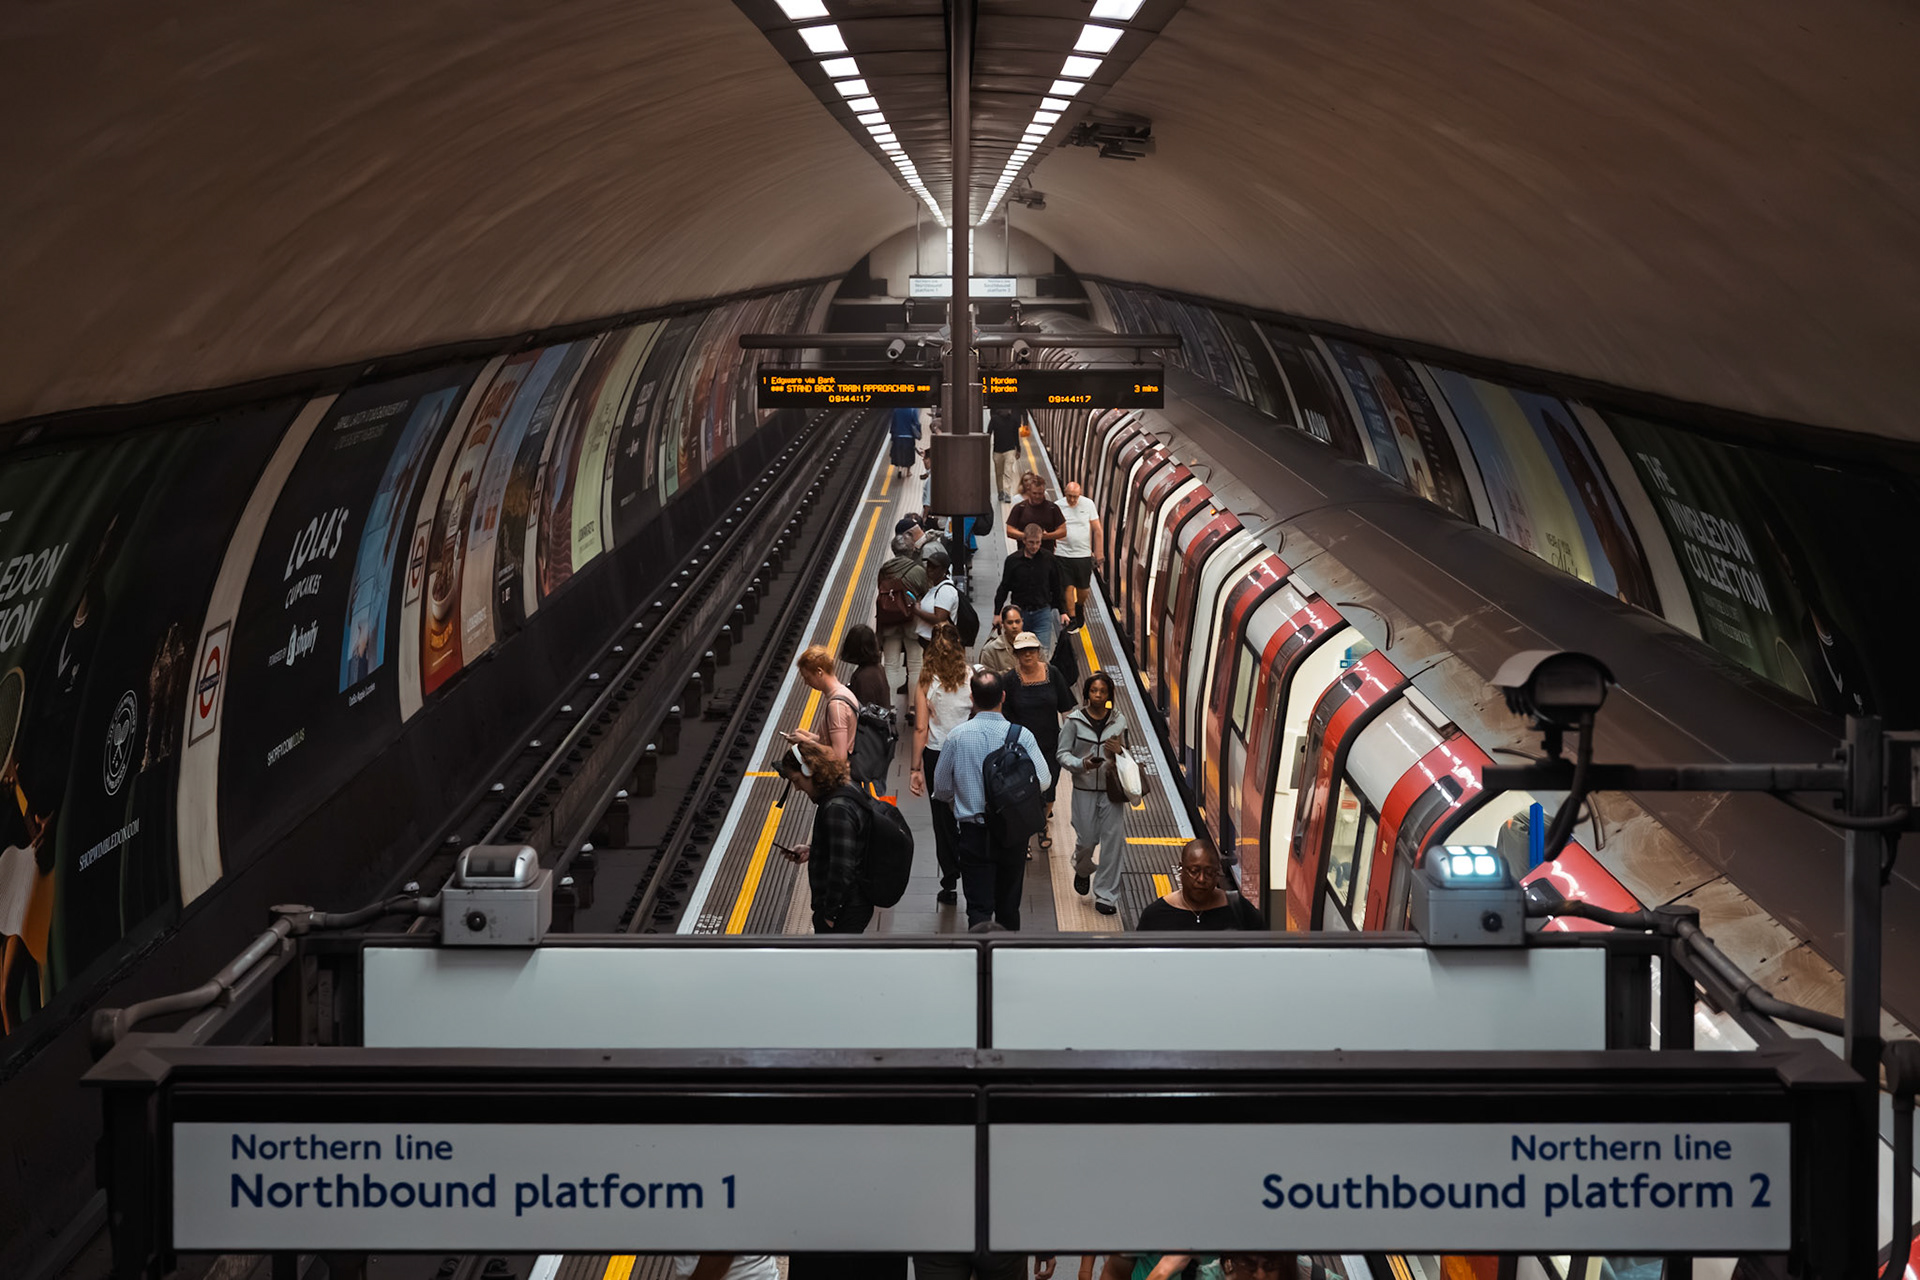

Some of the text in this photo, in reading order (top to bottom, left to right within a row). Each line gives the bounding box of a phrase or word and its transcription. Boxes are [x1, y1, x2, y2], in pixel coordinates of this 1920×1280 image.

[763, 377, 767, 385] 1
[771, 377, 803, 386] Edgware
[786, 385, 915, 393] STAND BACK TRAIN APPROACHING
[829, 395, 871, 403] 09:44:17
[990, 377, 1018, 385] Morden
[990, 385, 1018, 393] Morden
[1134, 385, 1140, 393] 3
[1142, 385, 1159, 393] mins
[1048, 395, 1092, 404] 09:44:17
[1637, 452, 1677, 495] THE
[283, 506, 350, 581] LOLA'S
[1661, 494, 1755, 565] WIMBLEDON
[0, 542, 69, 602] EDON
[1684, 540, 1773, 615] COLLECTION
[285, 574, 322, 610] CUPCAKES
[0, 597, 44, 653] ION
[294, 619, 319, 658] shopify
[78, 817, 140, 873] SHOPWIMBLEDON.COM
[231, 1134, 453, 1160] Northern line
[1511, 1134, 1732, 1161] Northern line
[230, 1173, 735, 1217] Northbound platform 1
[1261, 1172, 1771, 1217] Southbound platform 2
